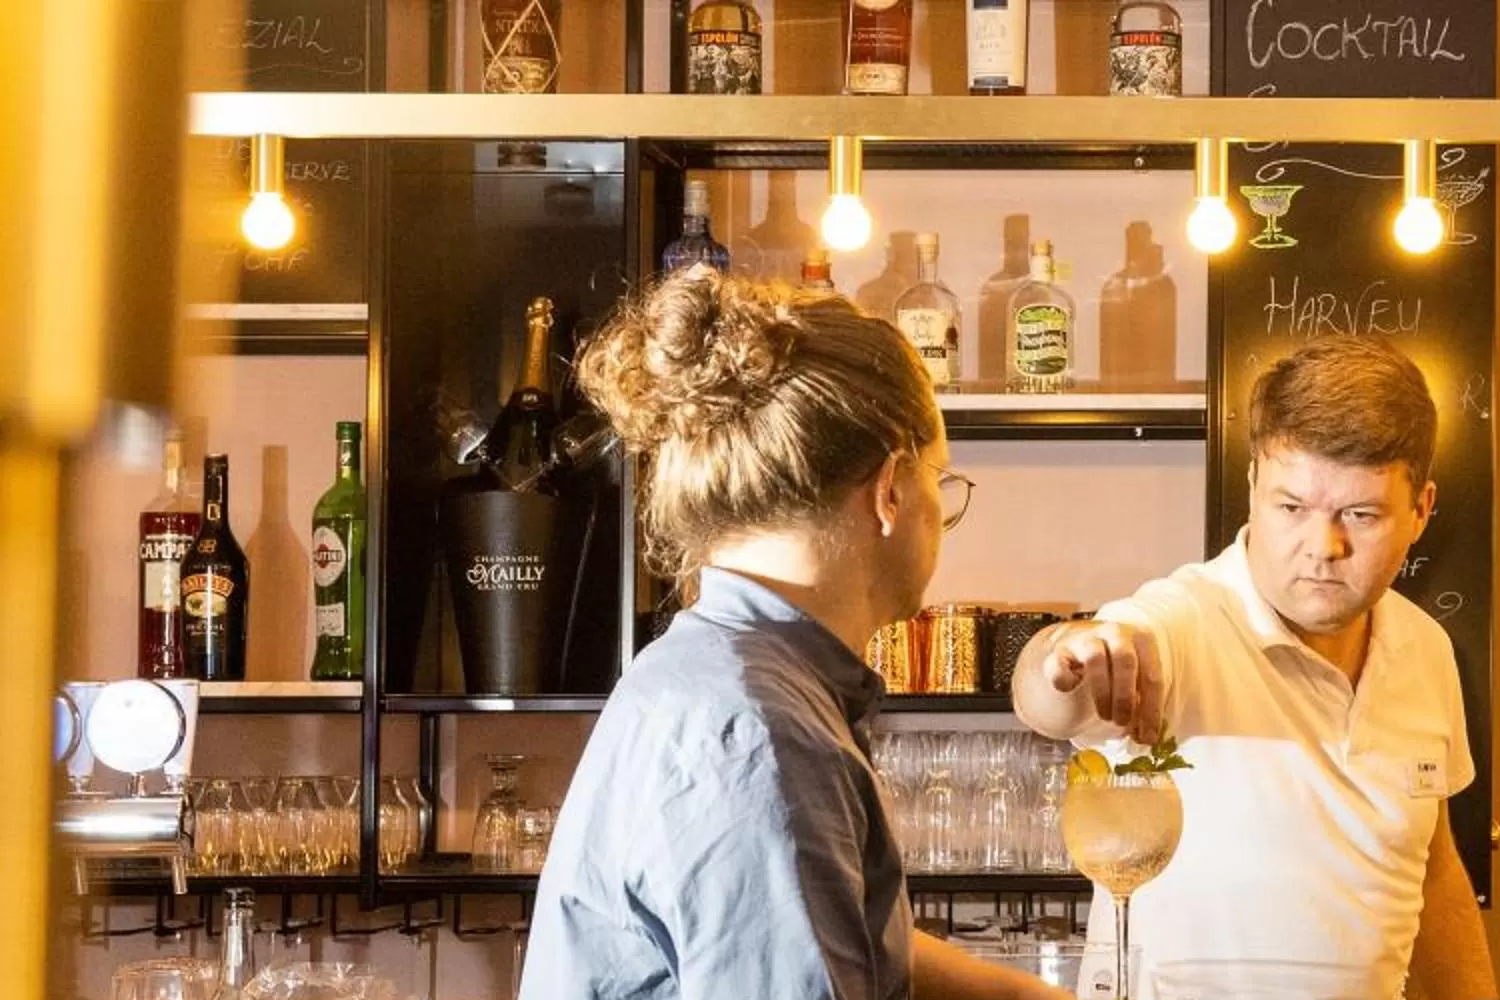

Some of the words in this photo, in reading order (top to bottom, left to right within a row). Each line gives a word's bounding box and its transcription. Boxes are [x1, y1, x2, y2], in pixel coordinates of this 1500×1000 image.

[222, 15, 333, 53] ZIAL
[1246, 0, 1466, 68] COCKTAIL
[139, 541, 191, 561] CAMPA
